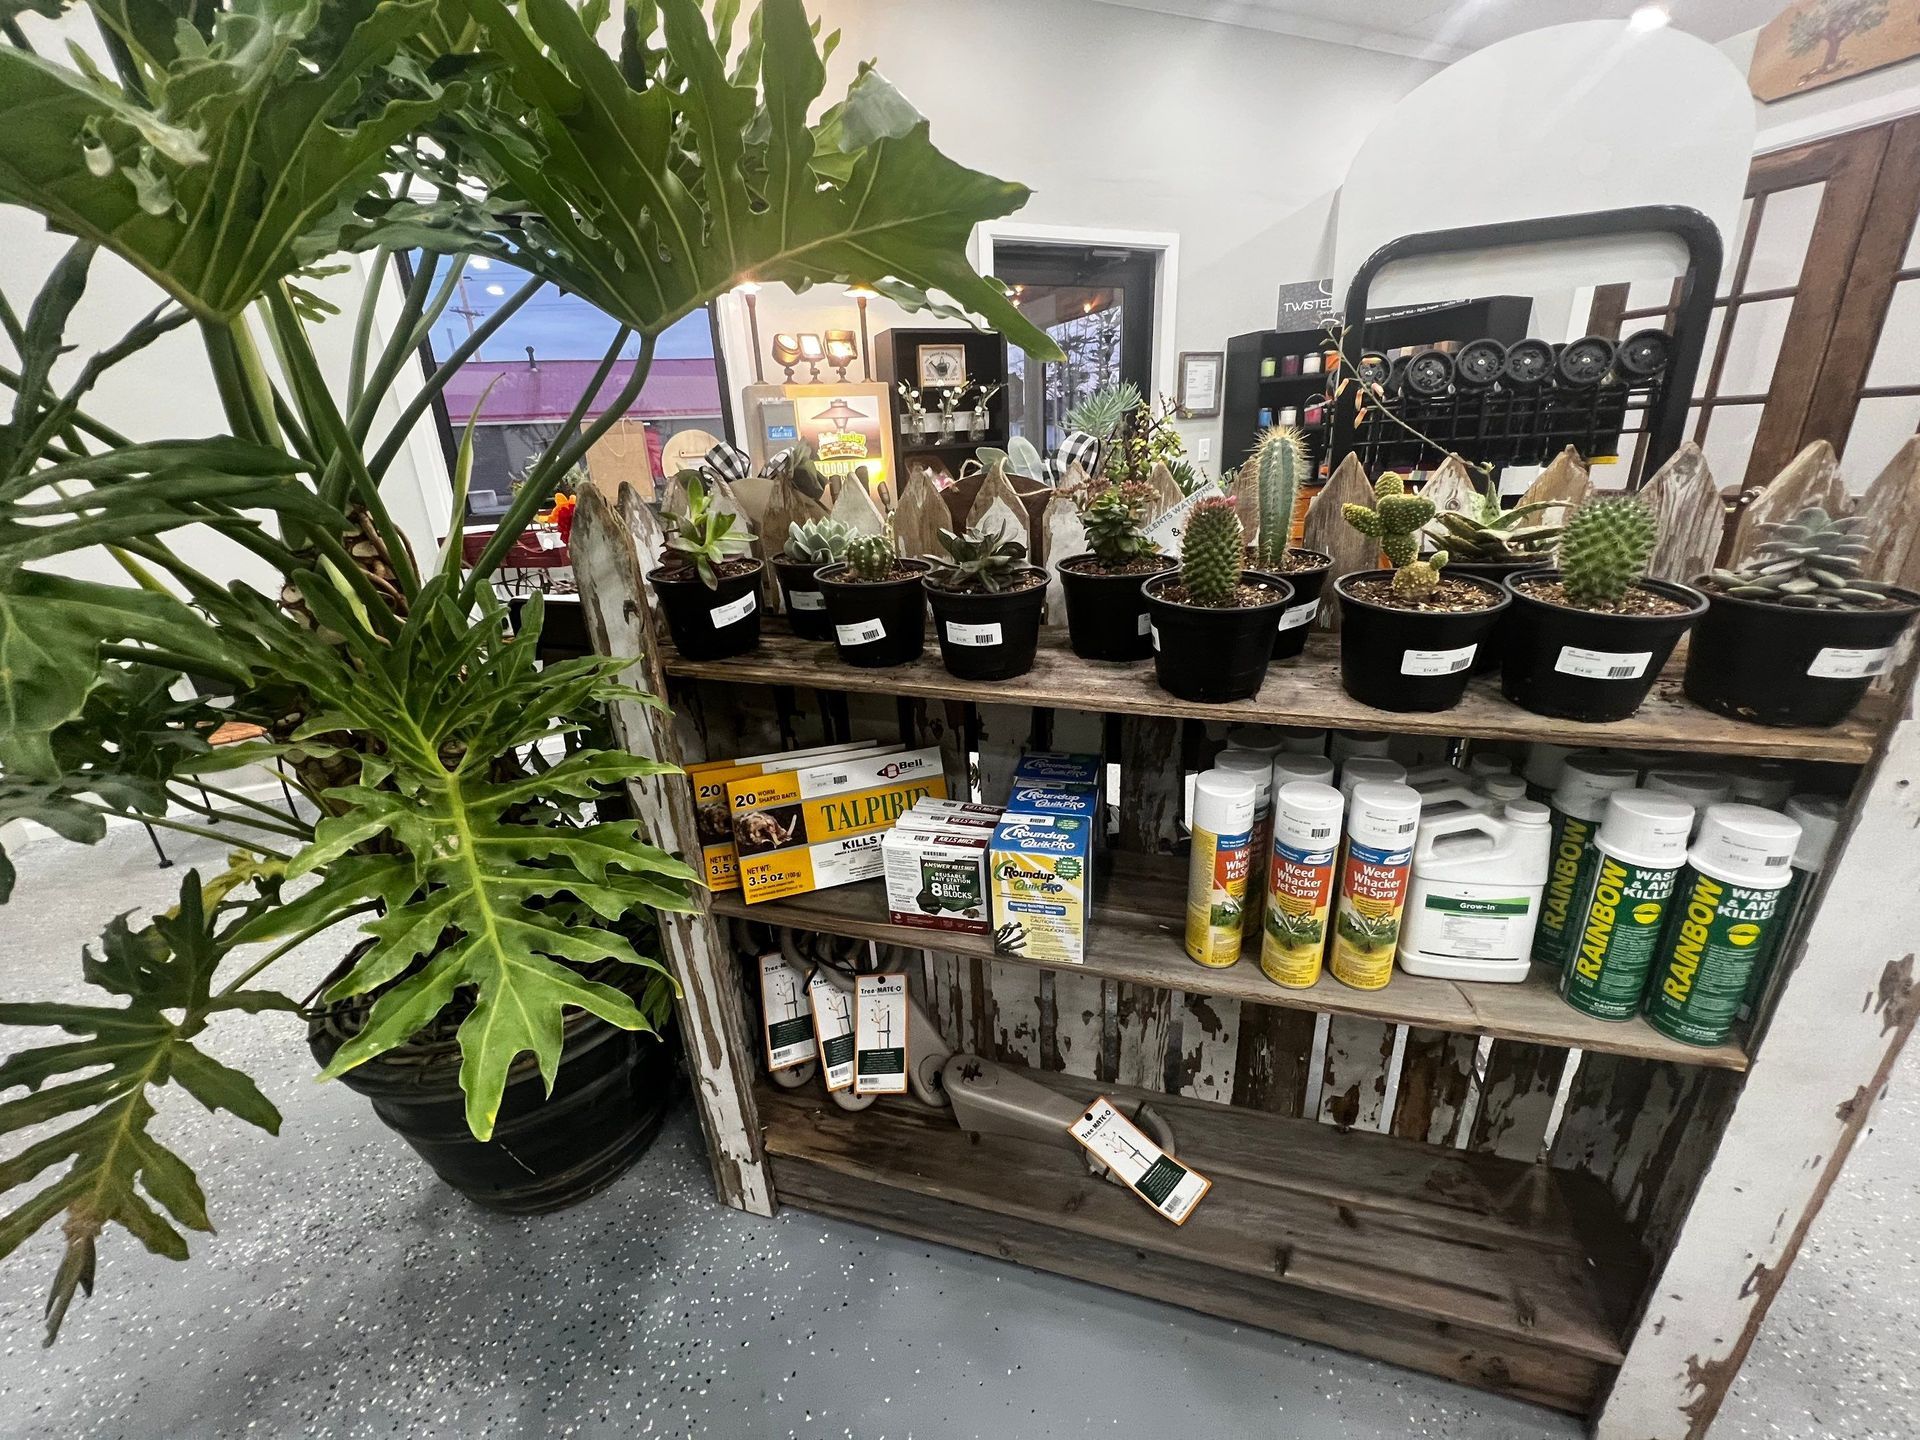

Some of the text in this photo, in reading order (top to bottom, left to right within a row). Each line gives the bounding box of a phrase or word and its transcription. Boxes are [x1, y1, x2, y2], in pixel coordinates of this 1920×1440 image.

[899, 758, 922, 769] Bell
[700, 784, 721, 798] 20
[735, 788, 776, 808] 20 WORM
[1027, 790, 1080, 802] Roundup
[758, 794, 781, 804] SHAPED
[1035, 799, 1086, 810] QuikPRO
[938, 836, 957, 844] KILLS
[1013, 827, 1070, 841] Roundup
[842, 835, 877, 851] KILLS
[1020, 838, 1076, 851] QuikPRO
[709, 855, 723, 865] NET
[711, 864, 730, 875] 3.5
[746, 865, 760, 875] NET
[934, 871, 966, 879] REUSABLE
[1003, 866, 1056, 883] Roundup
[1226, 870, 1239, 880] Jet
[1285, 862, 1316, 878] Weed
[1363, 864, 1396, 879] Weed
[1543, 818, 1588, 931] RAINBOW
[749, 874, 768, 886] 3.5
[770, 872, 784, 882] oz
[1277, 867, 1322, 888] Whacker
[1353, 871, 1402, 889] Whacker
[931, 882, 960, 897] 8 BAIT
[1014, 879, 1063, 894] QuikPRO
[1277, 879, 1320, 899] Jet Spray
[1353, 883, 1399, 899] Jet Spray
[943, 890, 973, 899] BLOCKS
[1745, 899, 1778, 911] ANT
[1577, 858, 1629, 981] RAINBOW
[1663, 875, 1724, 1003] RAINBOW
[1681, 1024, 1718, 1036] CAUTION
